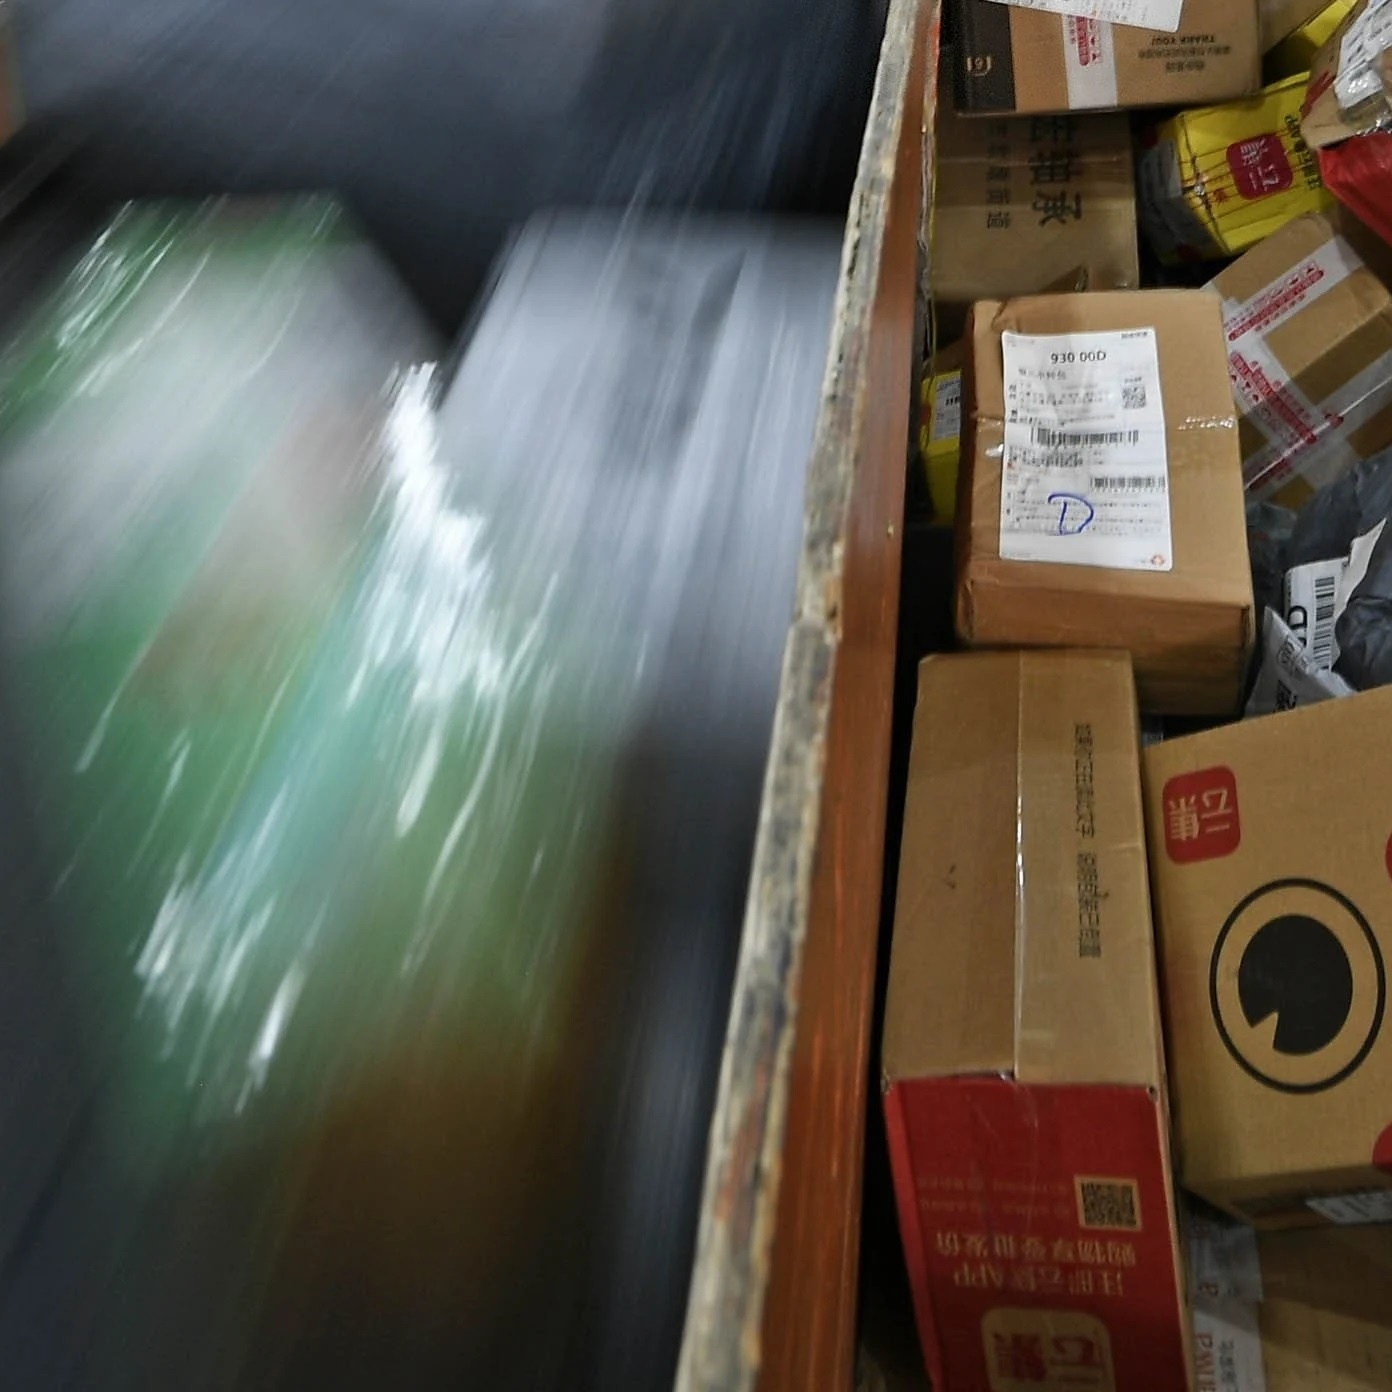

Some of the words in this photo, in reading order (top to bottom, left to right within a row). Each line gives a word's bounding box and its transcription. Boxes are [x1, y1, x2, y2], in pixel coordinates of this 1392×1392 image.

[1050, 351, 1076, 365] 930
[1047, 492, 1095, 537] D
[1167, 787, 1234, 844] 云集
